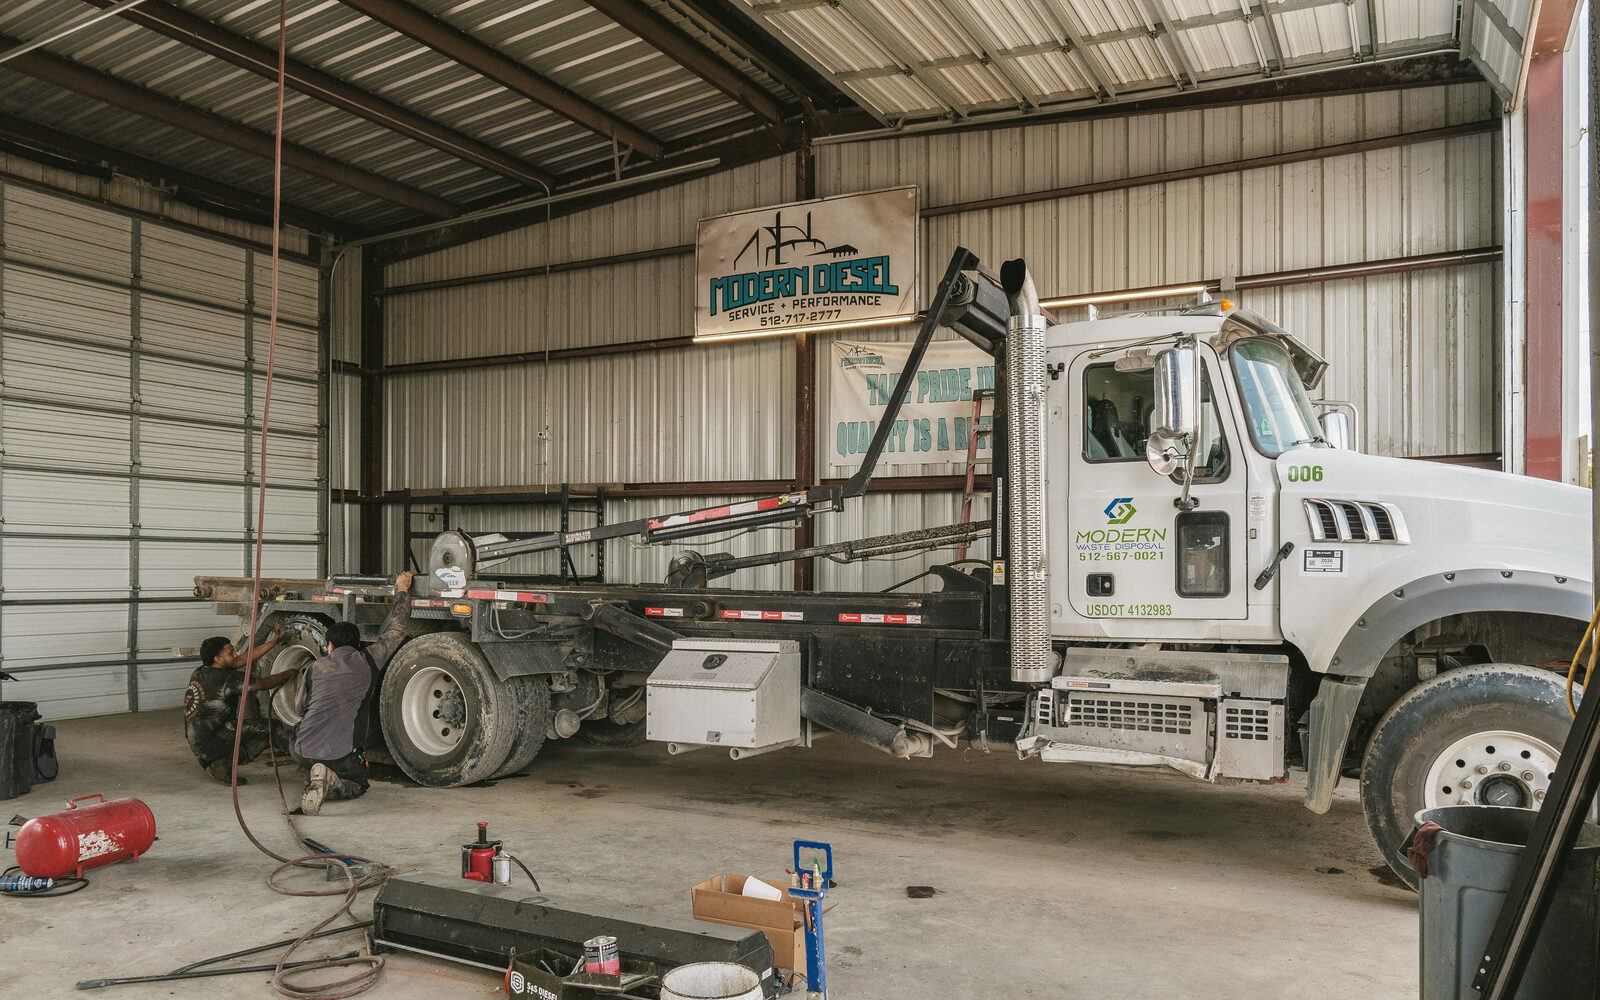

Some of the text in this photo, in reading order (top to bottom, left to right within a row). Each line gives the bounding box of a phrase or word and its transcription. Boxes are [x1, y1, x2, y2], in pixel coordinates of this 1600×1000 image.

[710, 255, 899, 316] MODERN DIESEL
[729, 303, 775, 322] SERVICE
[793, 296, 881, 309] PERFORMANCE
[866, 374, 911, 406] TA
[917, 368, 972, 403] PRIDE
[837, 420, 908, 457] QUATY
[913, 418, 932, 452] IS
[937, 418, 950, 451] A
[1288, 465, 1323, 482] 006
[1075, 527, 1167, 544] MODERN
[1115, 542, 1165, 551] DISPOSAL
[1079, 551, 1164, 561] 512-567-0021
[1086, 604, 1172, 616] USDOT 4132983
